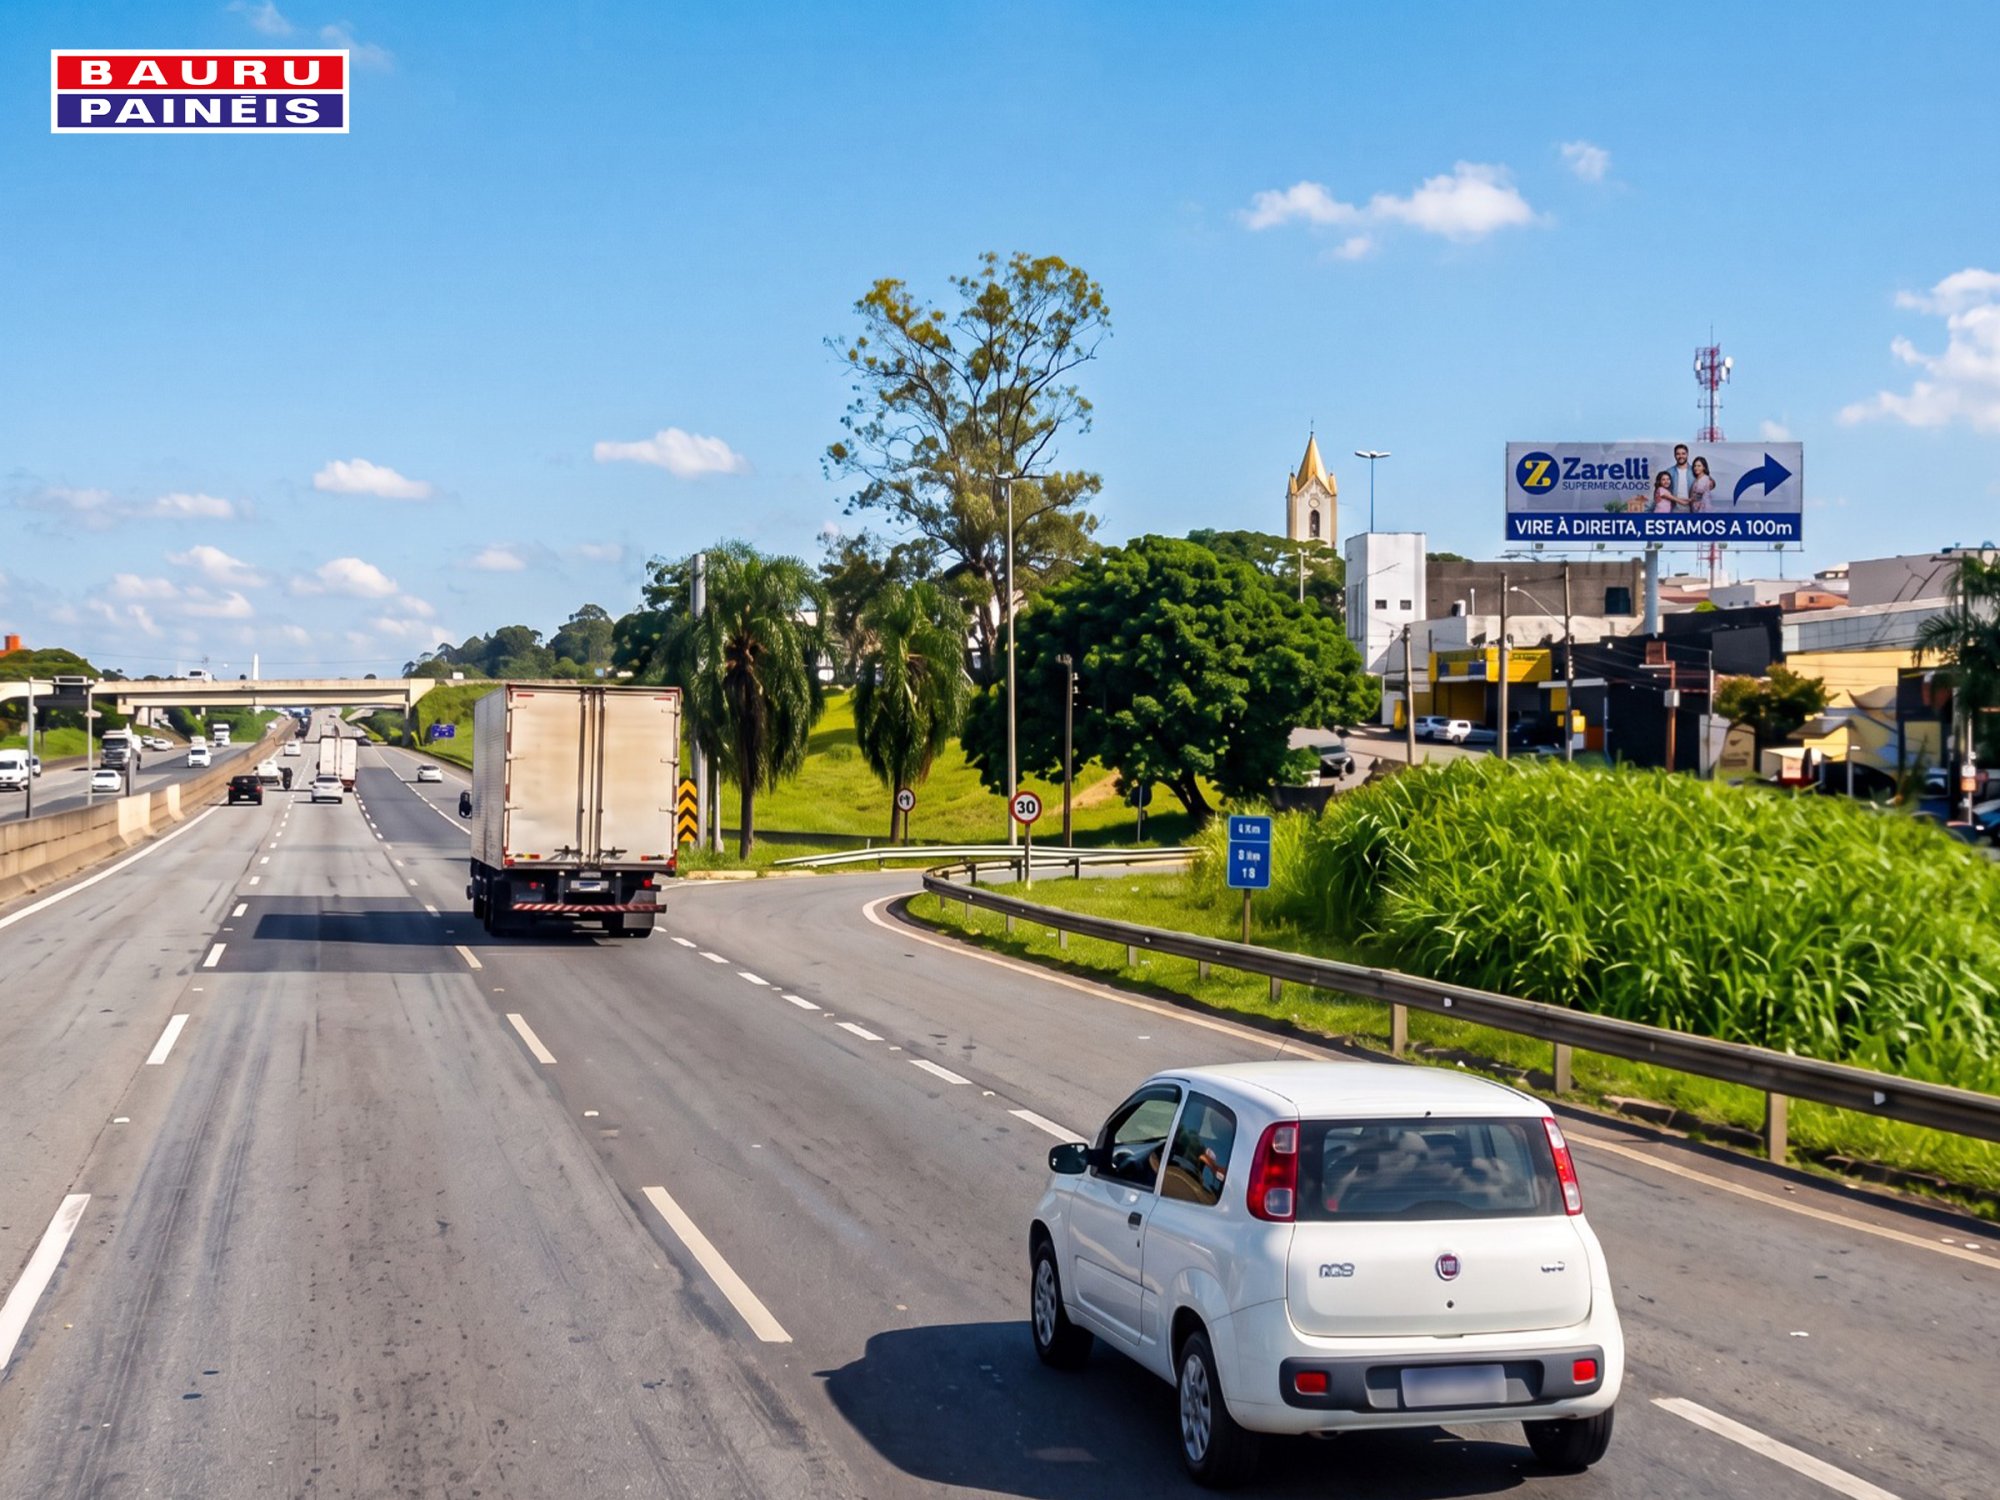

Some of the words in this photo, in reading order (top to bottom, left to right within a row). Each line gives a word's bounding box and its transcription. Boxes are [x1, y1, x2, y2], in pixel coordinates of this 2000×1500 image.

[1562, 457, 1651, 480] Zarelli
[1562, 481, 1651, 491] SUPERMERCADOS
[1515, 519, 1553, 535] VIRE
[1556, 516, 1570, 535] À
[1573, 519, 1642, 538] DIREITA,
[1645, 519, 1727, 535] ESTAMOS
[1729, 519, 1743, 535] A
[1746, 519, 1793, 535] 100m
[1016, 800, 1036, 814] 30
